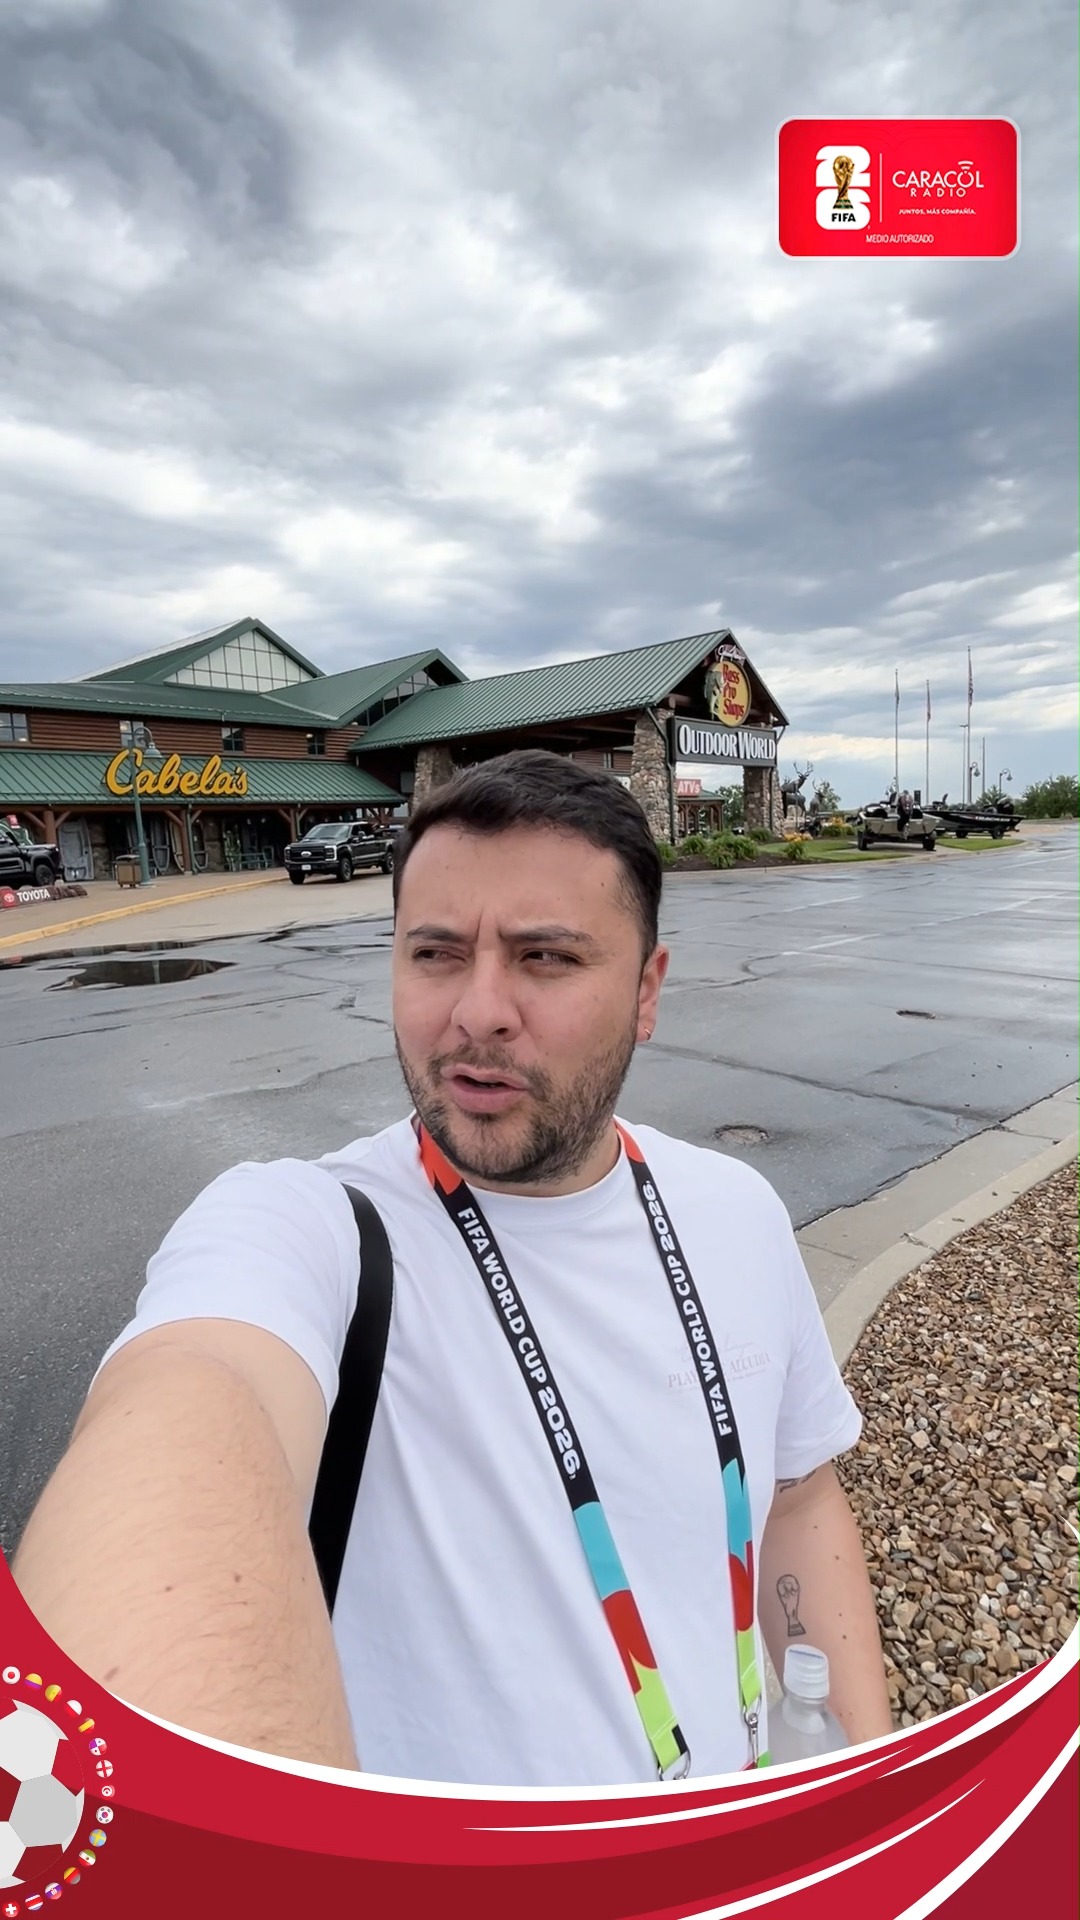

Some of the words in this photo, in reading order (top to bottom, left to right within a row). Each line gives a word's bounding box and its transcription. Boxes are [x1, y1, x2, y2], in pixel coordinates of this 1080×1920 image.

[723, 663, 740, 684] Bass
[723, 682, 737, 699] Pro
[723, 698, 744, 720] Shops
[106, 749, 248, 796] Cabela's
[677, 780, 700, 794] ATVs
[17, 888, 51, 902] TOYOTA
[642, 1180, 676, 1252] 2026
[666, 1254, 691, 1296] CUP
[457, 1207, 491, 1254] FIFA
[482, 1251, 526, 1335] WORLD
[518, 1336, 548, 1384] CUP
[537, 1385, 581, 1480] 2026
[682, 1298, 718, 1383] WORLD
[708, 1382, 732, 1437] FIFA
